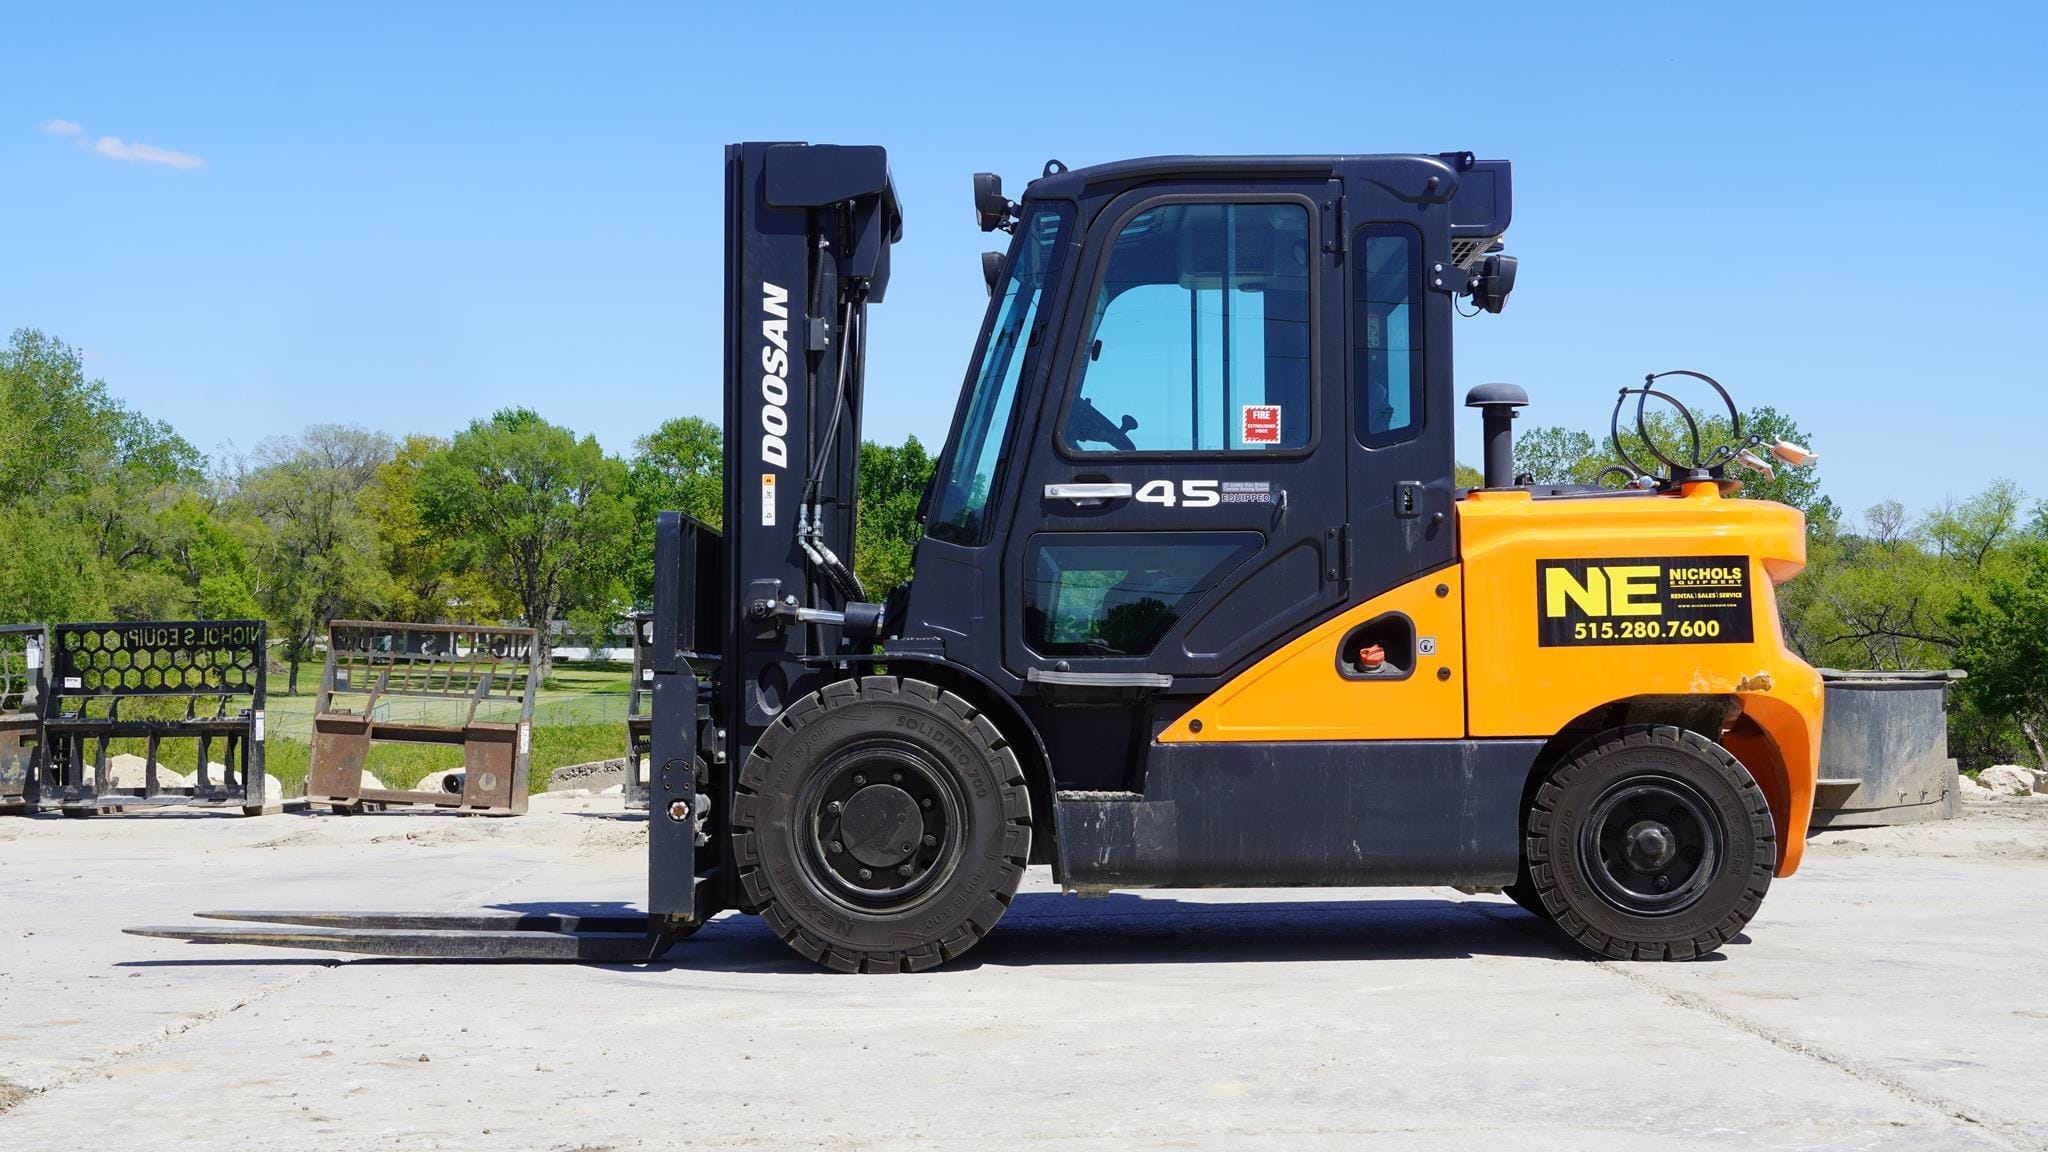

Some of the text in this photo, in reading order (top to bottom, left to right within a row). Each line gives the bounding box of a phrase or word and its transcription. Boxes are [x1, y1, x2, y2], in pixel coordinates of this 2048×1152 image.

[762, 282, 788, 469] DOOSAN
[1252, 410, 1271, 420] FIRE
[1135, 480, 1221, 507] 45
[1221, 493, 1271, 503] EQUIPPED
[1669, 567, 1742, 580] NICHOLS
[1545, 565, 1662, 617] NE
[1574, 620, 1720, 640] 515.280.7600
[896, 715, 988, 798] SOLIDPRO 700
